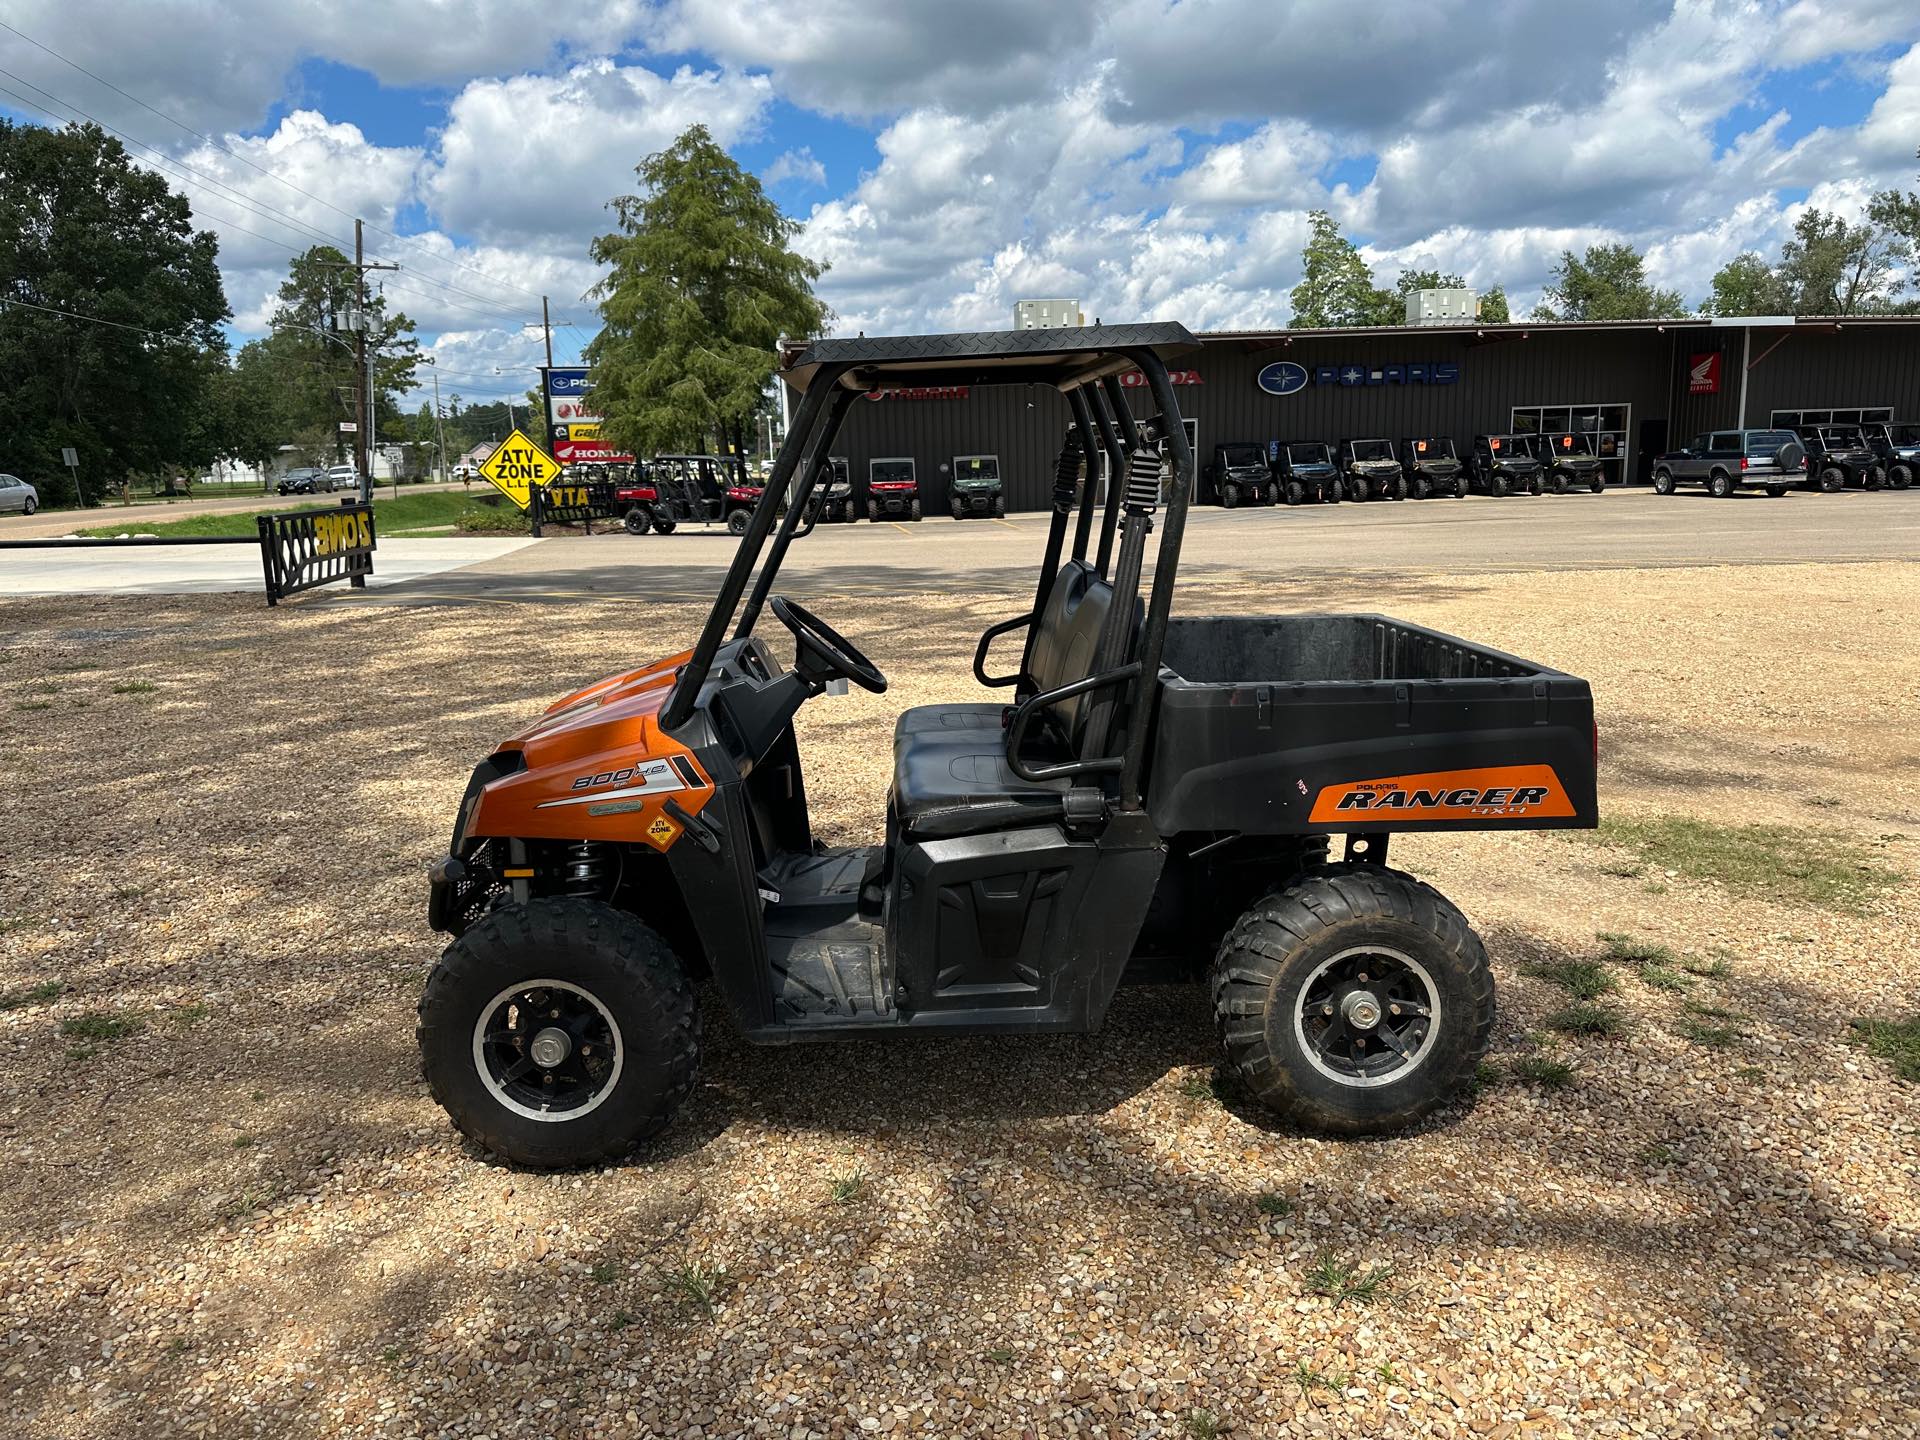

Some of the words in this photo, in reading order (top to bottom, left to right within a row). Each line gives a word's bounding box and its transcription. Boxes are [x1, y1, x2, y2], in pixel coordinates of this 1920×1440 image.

[1095, 369, 1204, 387] ODA
[1316, 363, 1458, 385] POLARIS
[570, 379, 598, 387] POL
[387, 455, 399, 463] 35
[501, 449, 534, 464] ATV
[495, 464, 544, 479] ZONE
[506, 480, 530, 488] L.L.
[571, 768, 635, 790] 800
[1335, 787, 1549, 810] RANGER
[651, 826, 671, 834] ZONE
